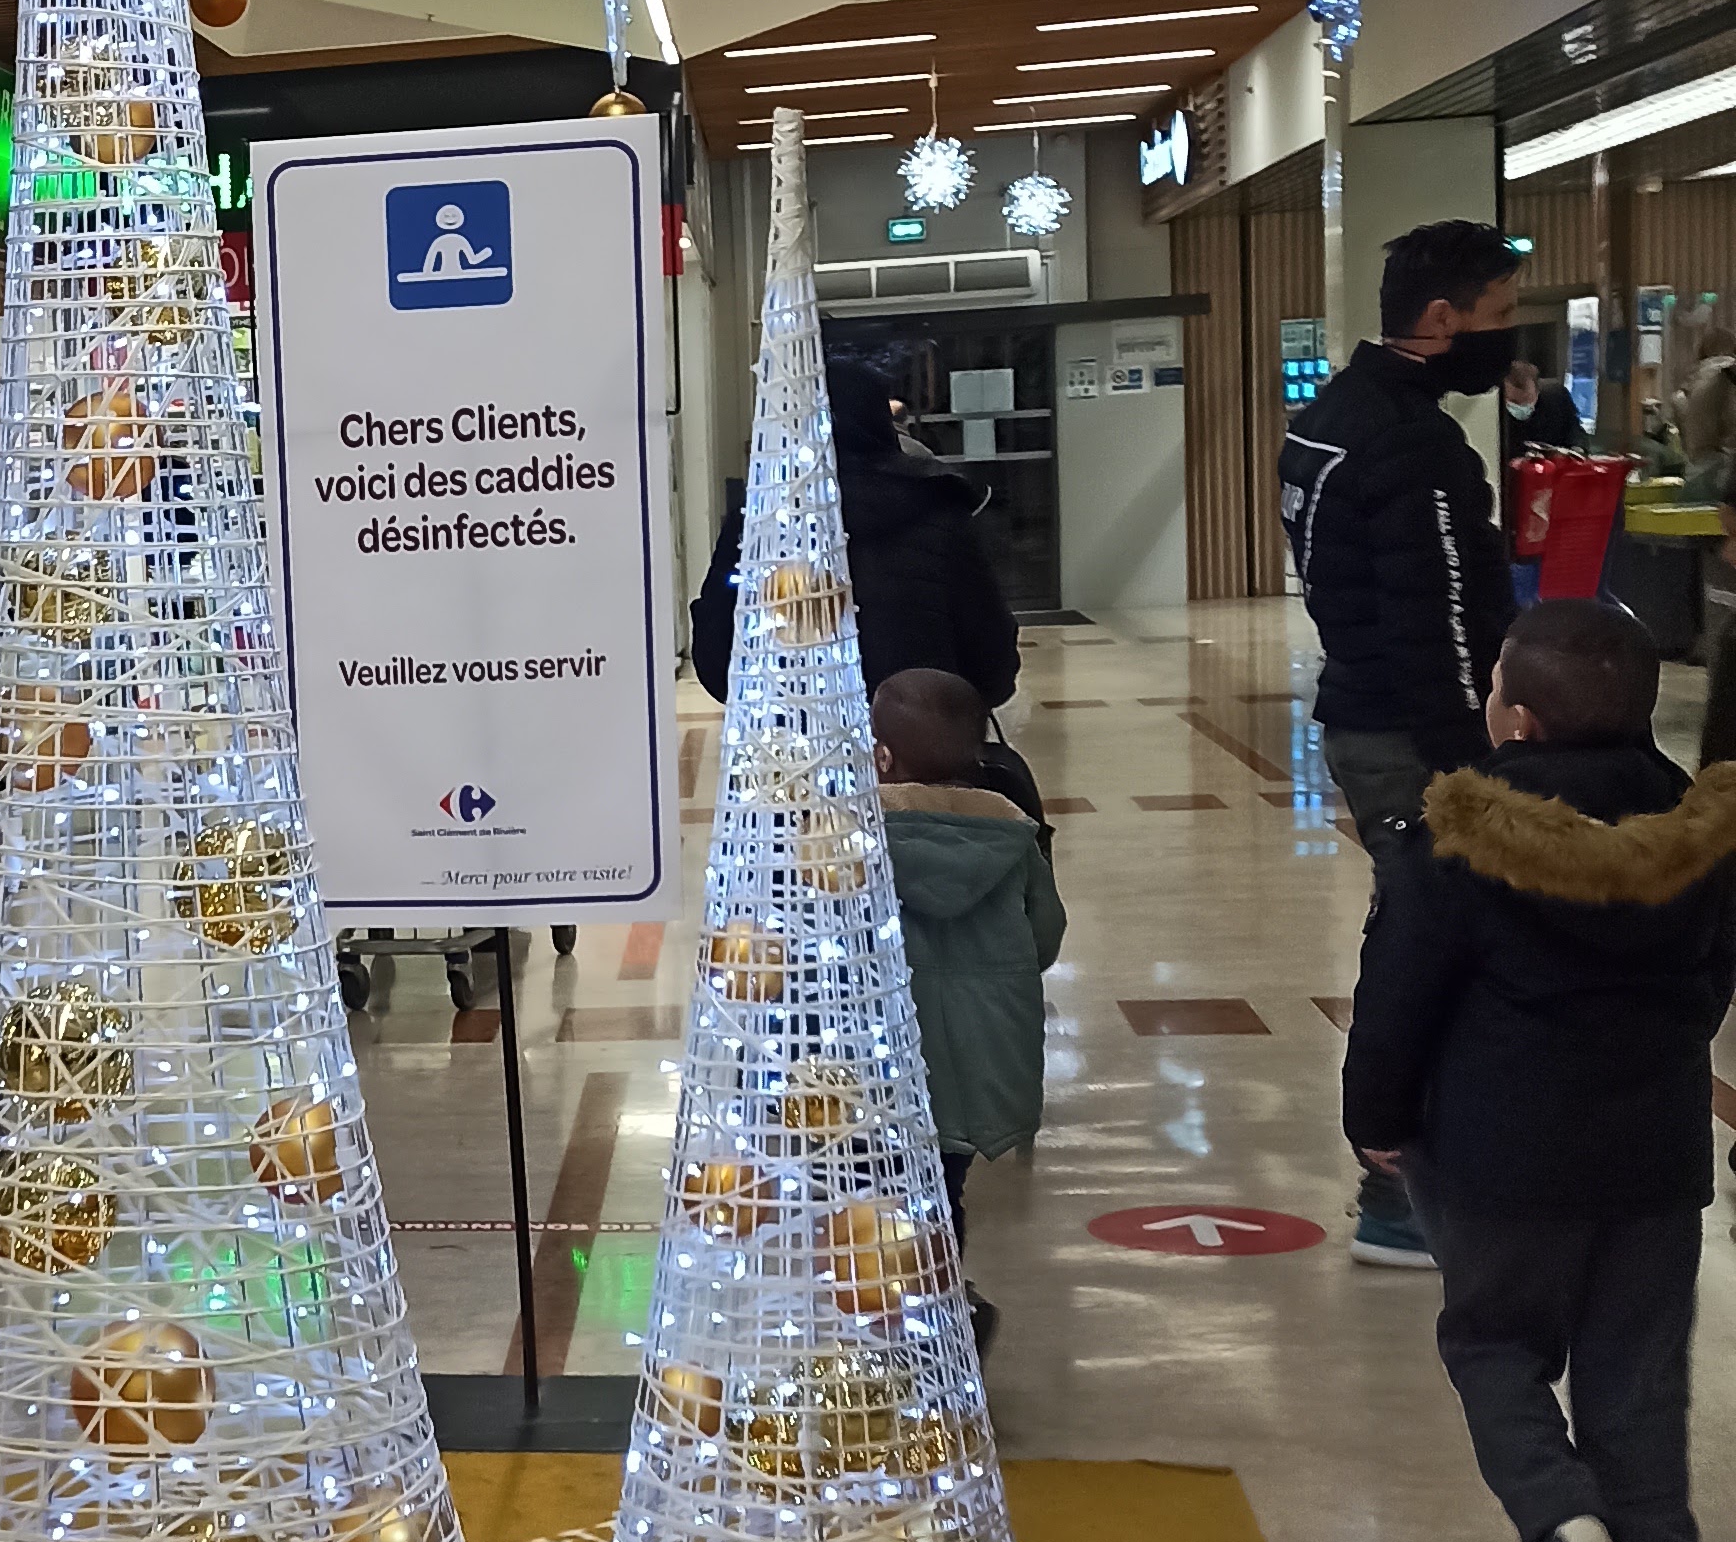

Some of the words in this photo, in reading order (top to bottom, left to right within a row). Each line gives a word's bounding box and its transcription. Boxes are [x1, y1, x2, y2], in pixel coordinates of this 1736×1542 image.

[340, 414, 447, 449] Chers
[452, 405, 588, 447] Clients,
[314, 464, 397, 504] voici
[404, 460, 467, 501] des
[475, 455, 616, 496] caddies
[357, 508, 578, 554] désinfectés.
[339, 655, 448, 689] Veuillez
[452, 657, 519, 685] vous
[524, 650, 607, 681] servir
[411, 828, 435, 838] Saint
[479, 828, 491, 837] de
[493, 871, 531, 890] pour
[536, 869, 577, 884] votre
[582, 865, 633, 880] visite!
